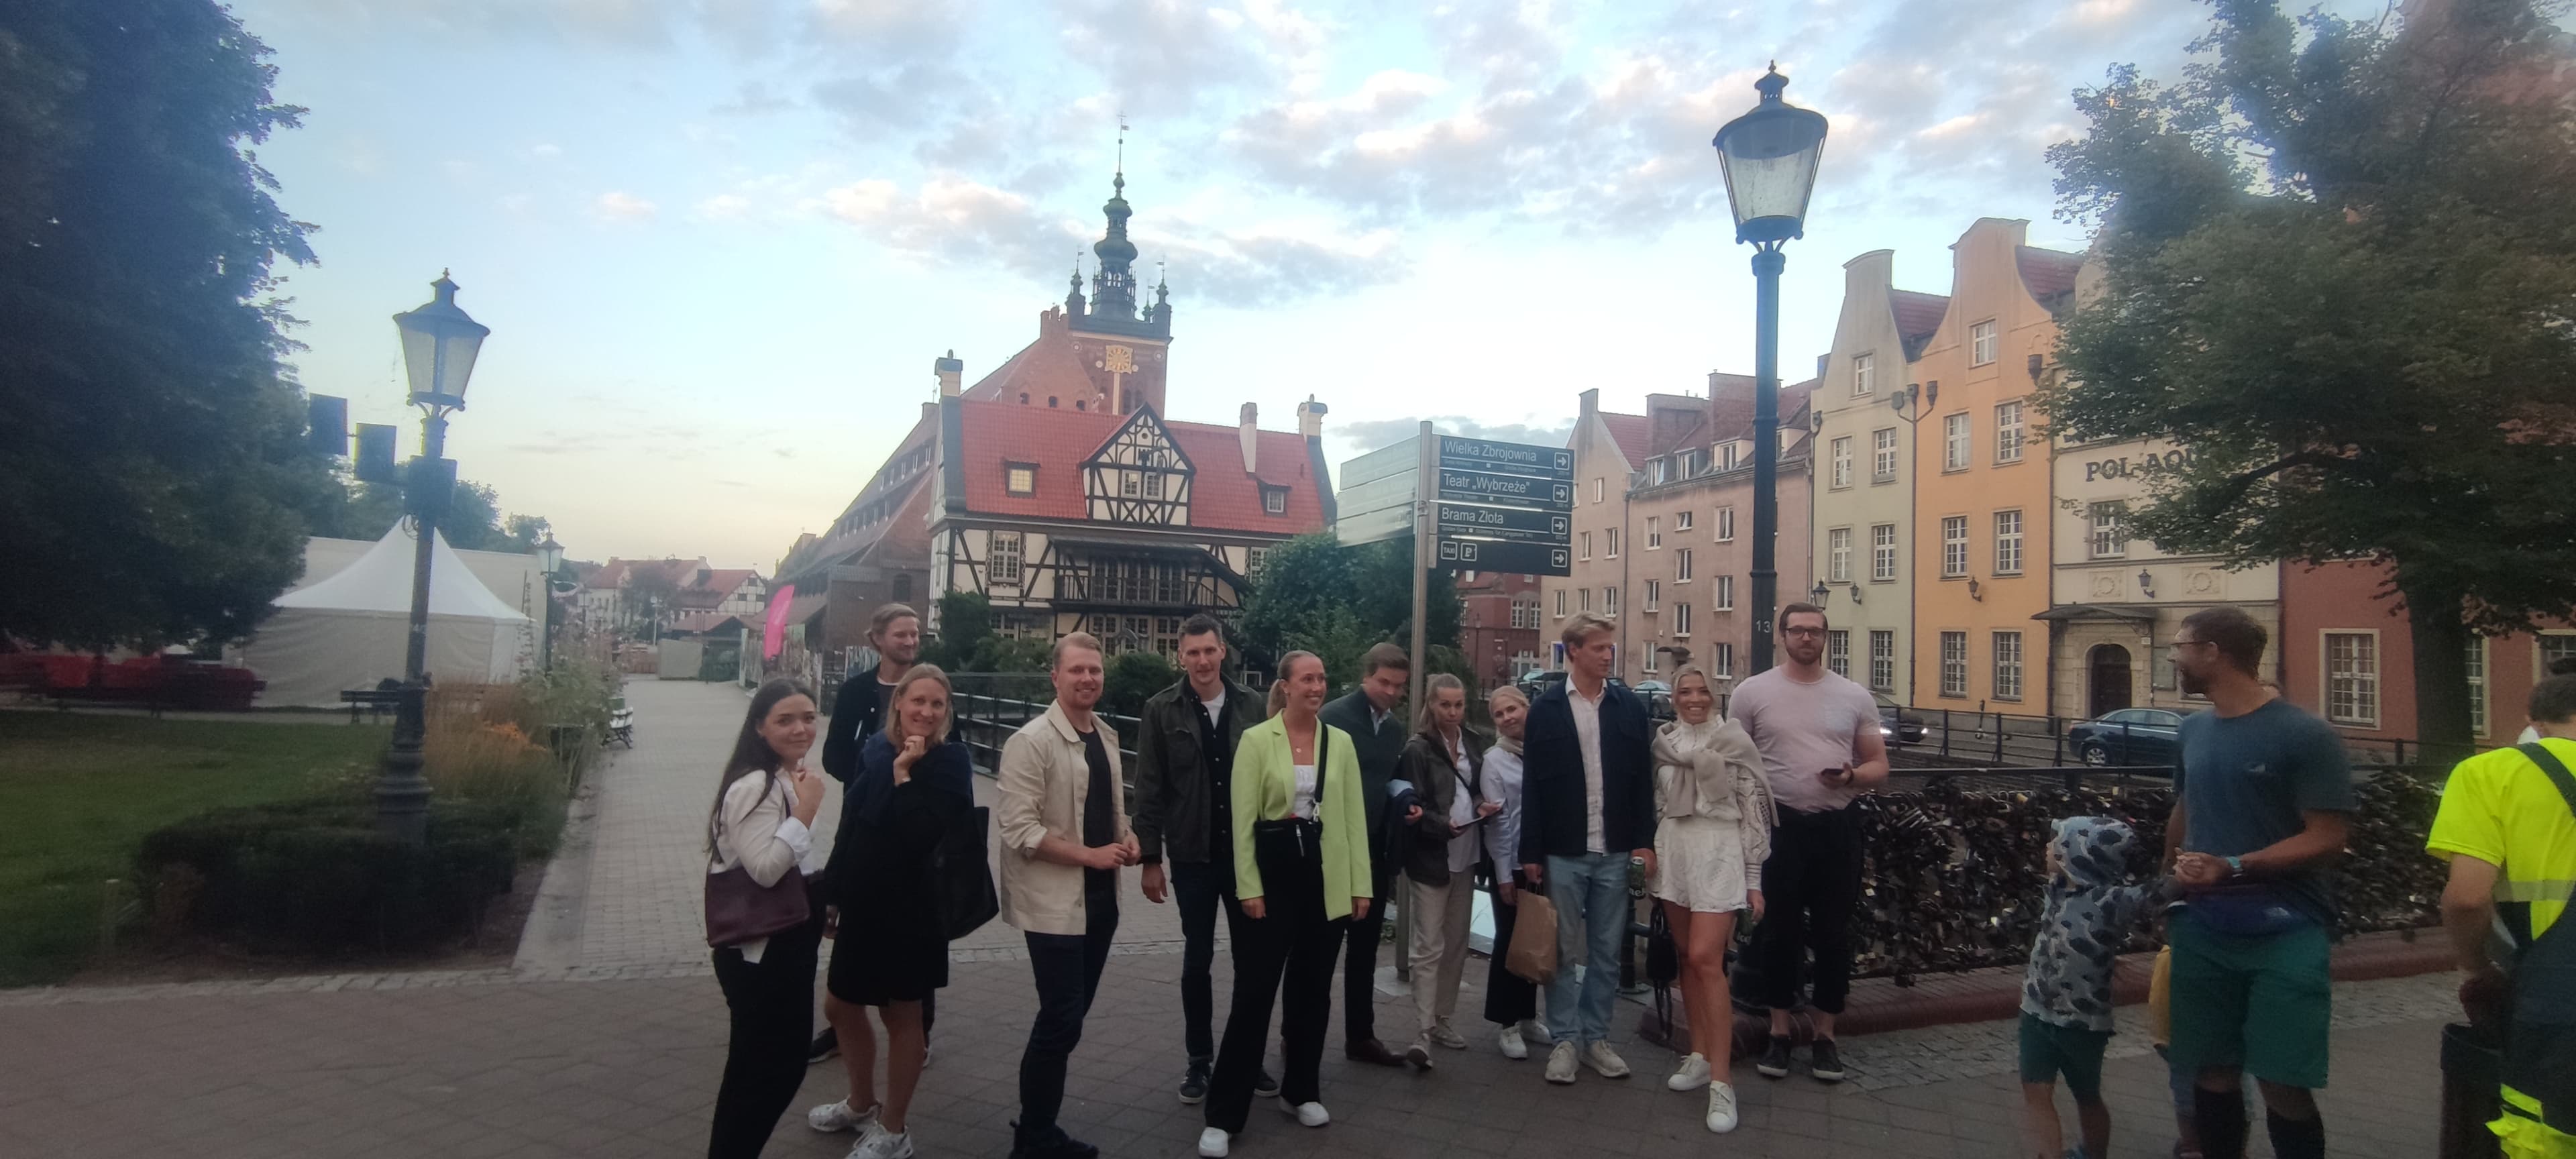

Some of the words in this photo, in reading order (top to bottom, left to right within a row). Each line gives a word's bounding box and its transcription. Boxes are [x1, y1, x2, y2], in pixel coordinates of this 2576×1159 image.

[1444, 439, 1479, 456] Wielka
[1481, 444, 1537, 461] Zbrojownia
[1444, 474, 1470, 488] Teatr
[1442, 507, 1476, 522] Brama
[1478, 510, 1504, 525] Złota
